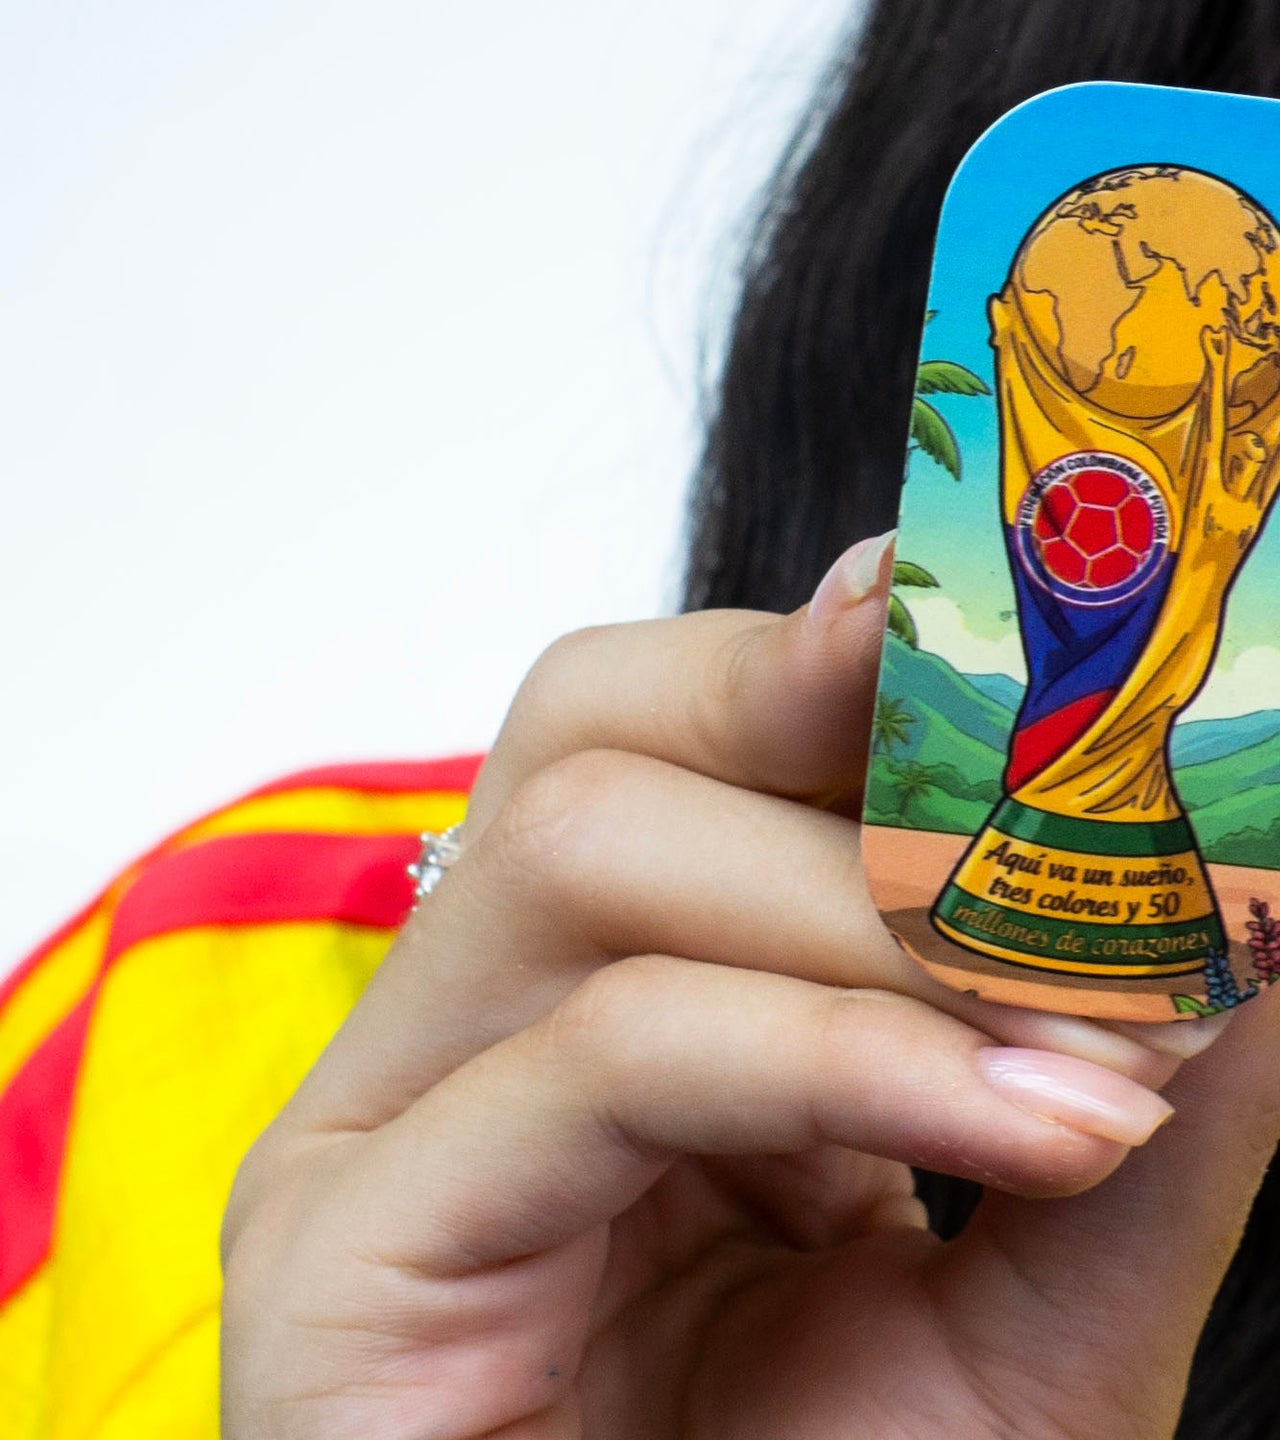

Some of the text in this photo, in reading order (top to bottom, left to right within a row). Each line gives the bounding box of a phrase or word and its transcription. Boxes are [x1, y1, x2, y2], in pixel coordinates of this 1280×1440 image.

[982, 839, 1195, 887] Aquí va un sueño,
[987, 875, 1181, 925] tres colores y 50
[952, 904, 1210, 959] millones de corazones
